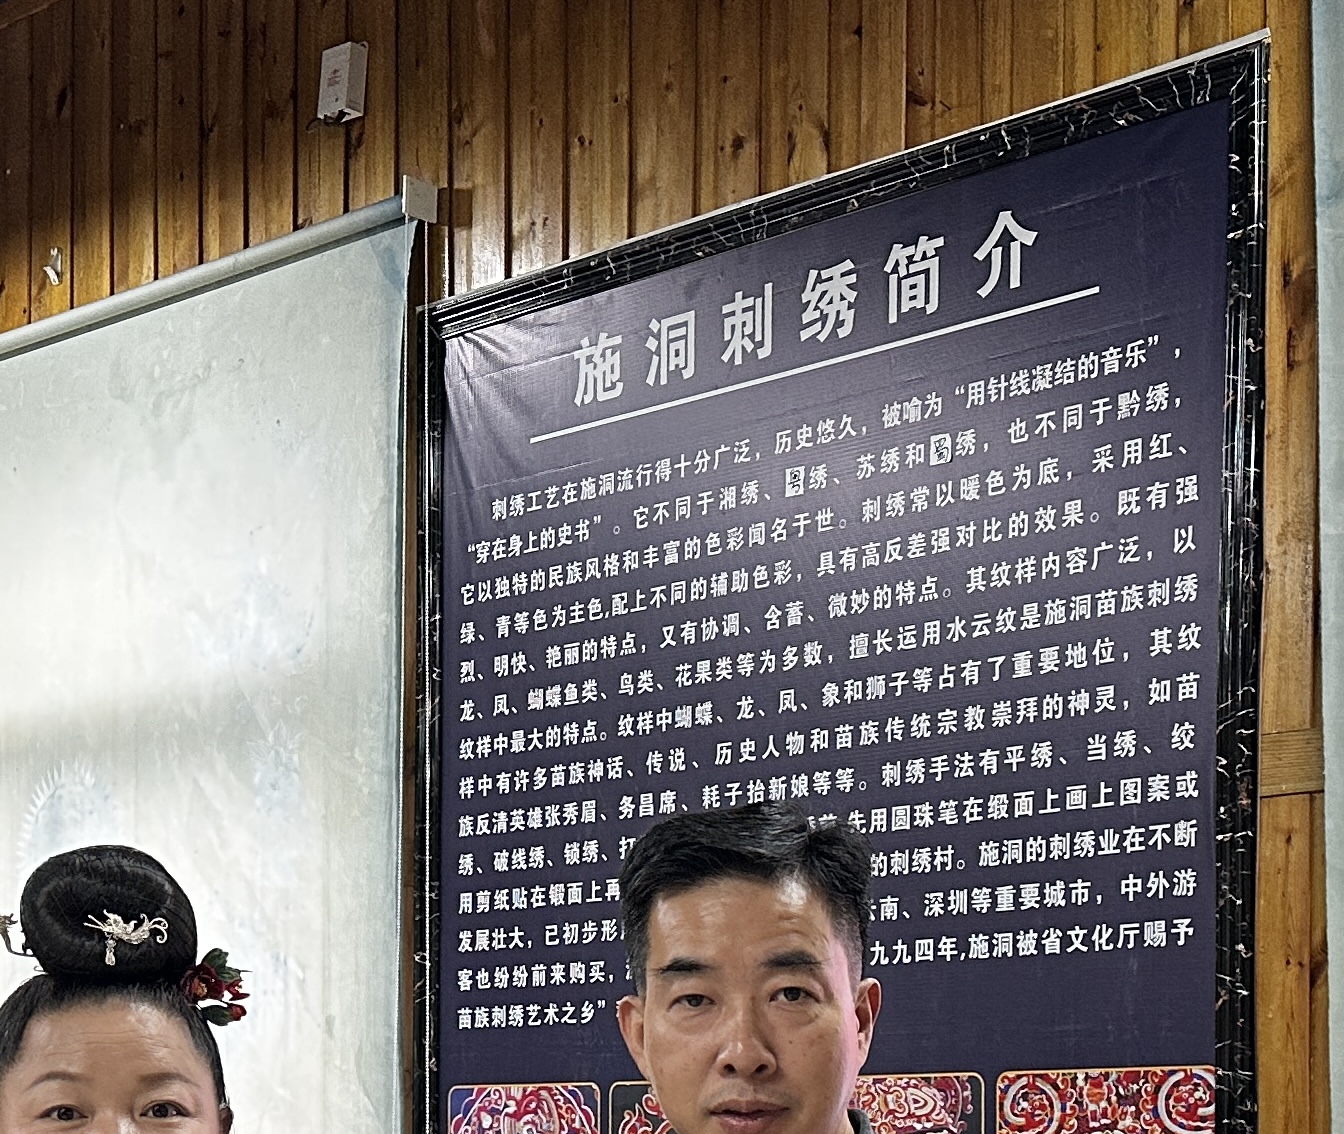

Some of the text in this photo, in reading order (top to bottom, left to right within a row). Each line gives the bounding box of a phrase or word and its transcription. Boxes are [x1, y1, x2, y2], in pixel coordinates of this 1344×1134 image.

[573, 210, 1042, 408] 施洞刺绣简介
[457, 918, 625, 953] 发展壮大，已初步形
[457, 958, 633, 991] 客也纷纷前来购买，
[457, 1000, 619, 1030] 苗族刺绣艺术之乡”
